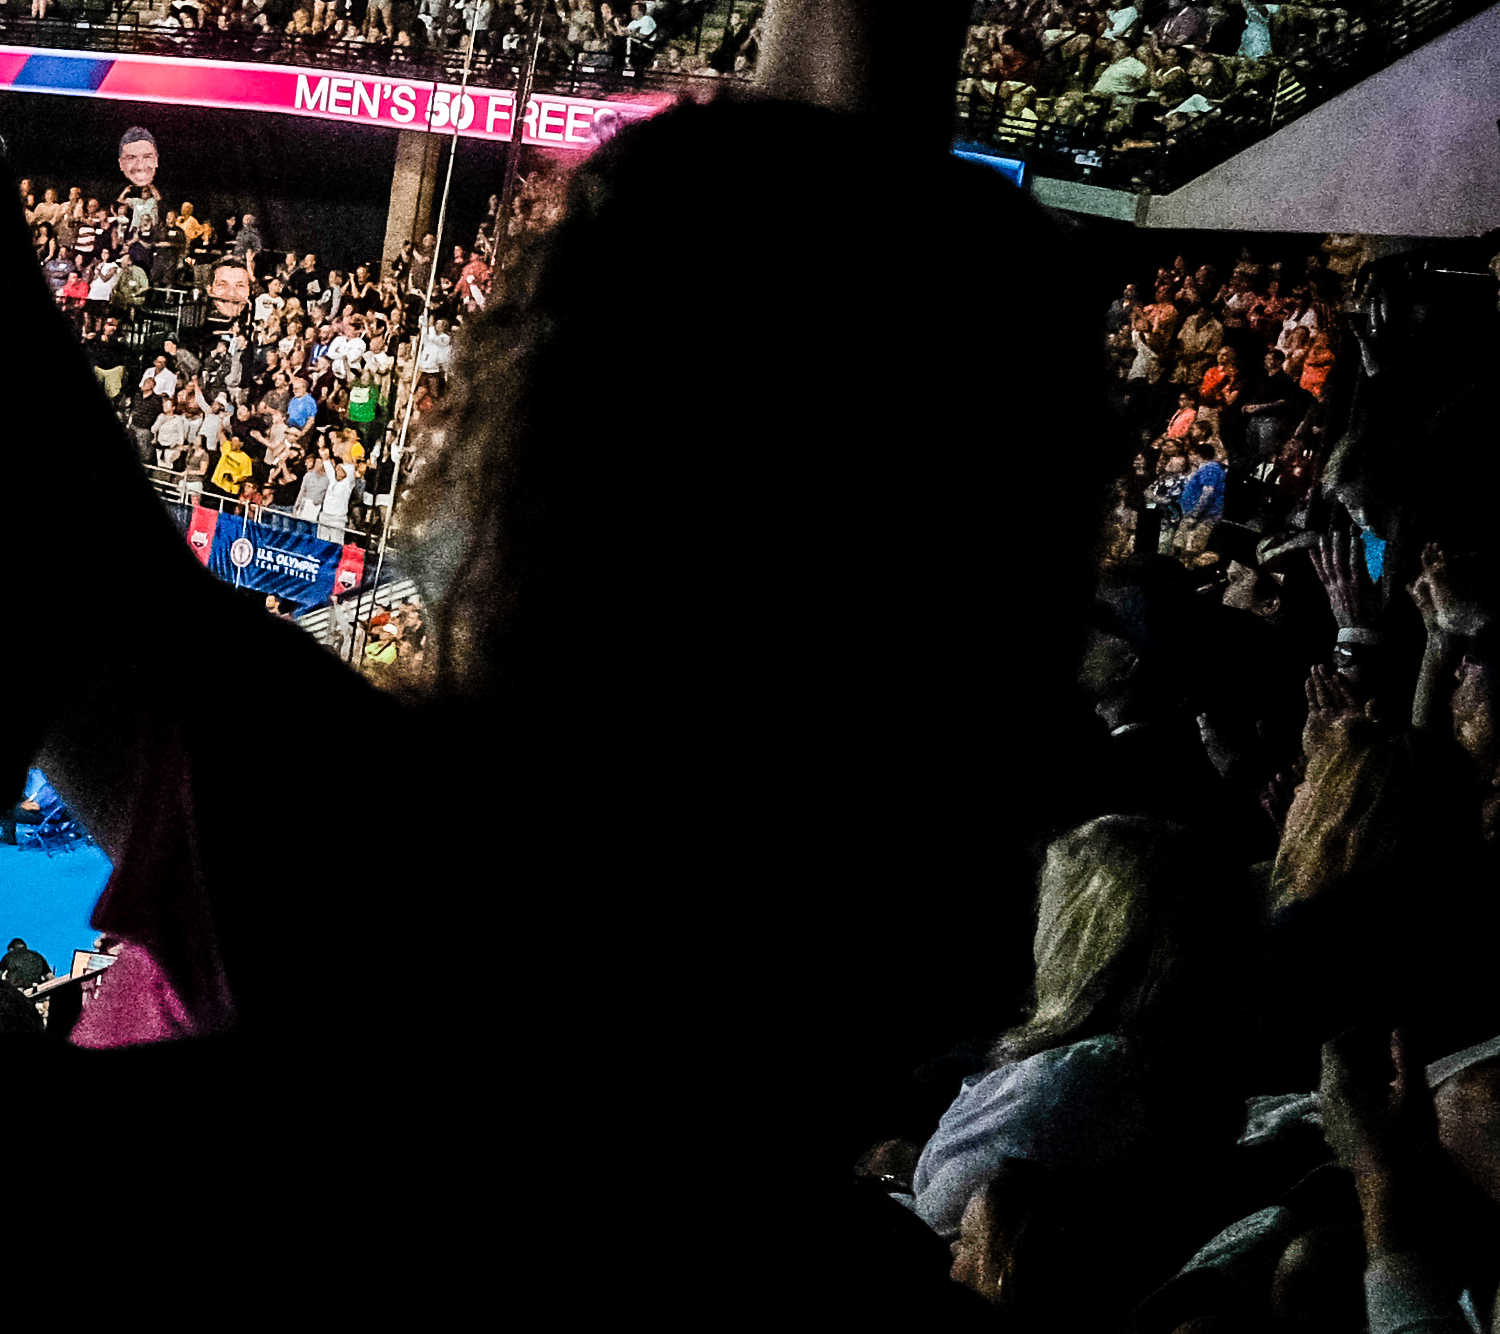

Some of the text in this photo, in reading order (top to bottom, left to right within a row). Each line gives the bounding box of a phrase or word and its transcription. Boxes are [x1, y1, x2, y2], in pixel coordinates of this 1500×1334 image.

[294, 74, 475, 130] MEN'S 50
[256, 548, 320, 574] U.S. OLYMPIC
